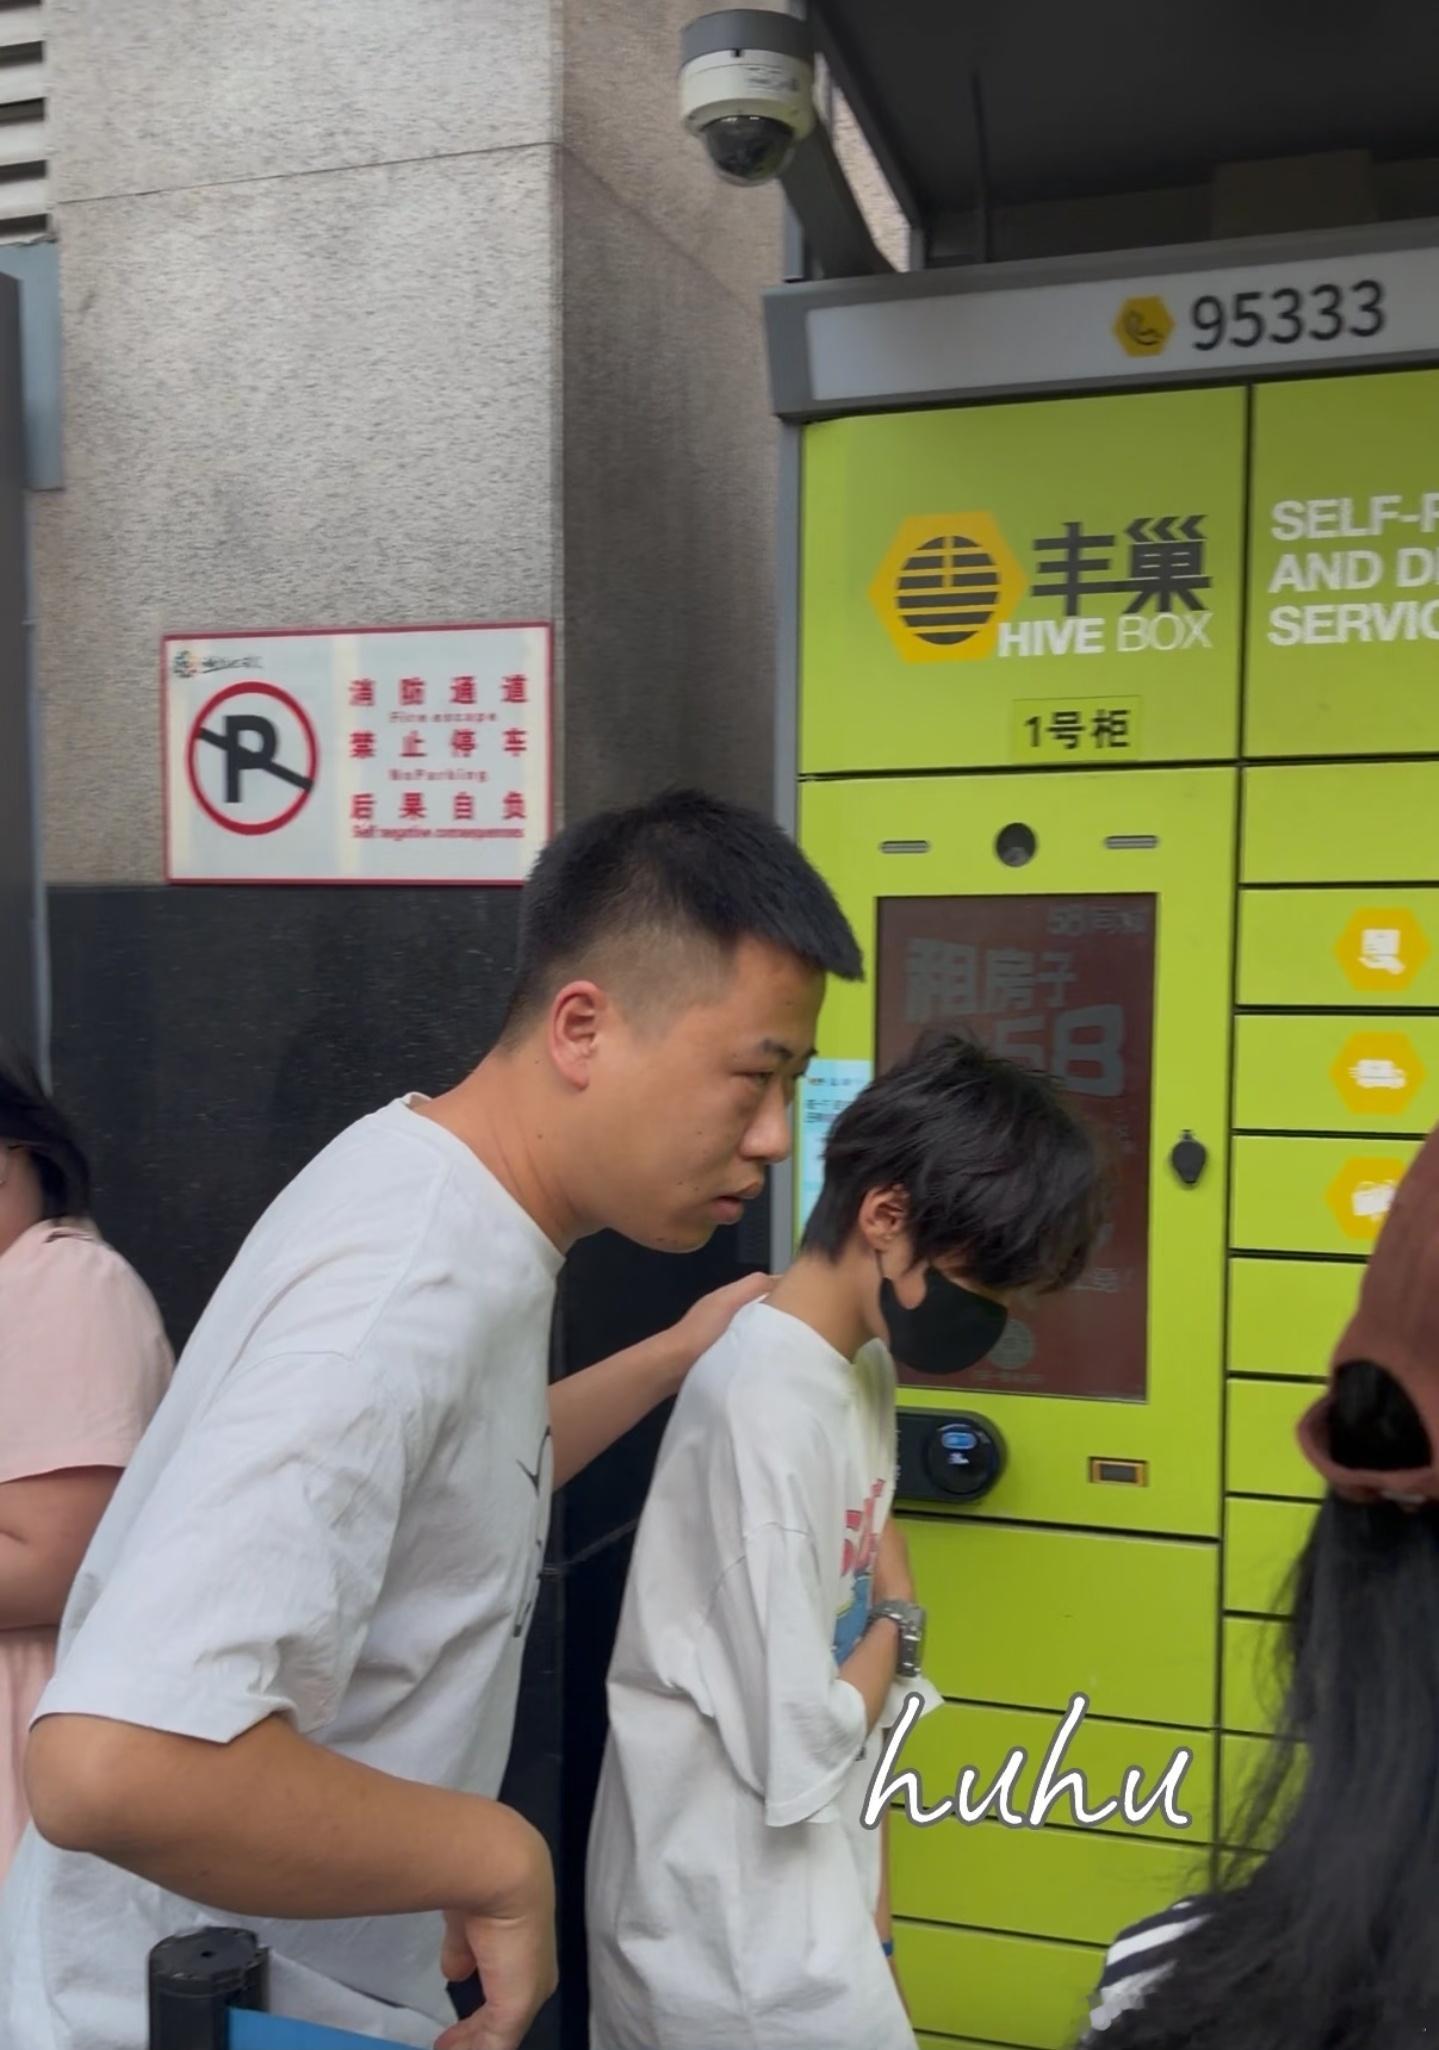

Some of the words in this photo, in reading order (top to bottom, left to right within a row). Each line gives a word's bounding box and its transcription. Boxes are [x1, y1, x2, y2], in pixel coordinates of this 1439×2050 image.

[1191, 280, 1387, 351] 95333
[1030, 514, 1213, 617] 丰巢
[1268, 550, 1384, 593] AND
[1396, 547, 1439, 588] D
[998, 617, 1105, 657] HIVE
[1115, 613, 1215, 652] BOX
[350, 675, 529, 706] 消防通道
[350, 727, 527, 759] 禁止停车
[1024, 708, 1132, 750] 1号柜
[350, 790, 527, 820] 后果自负
